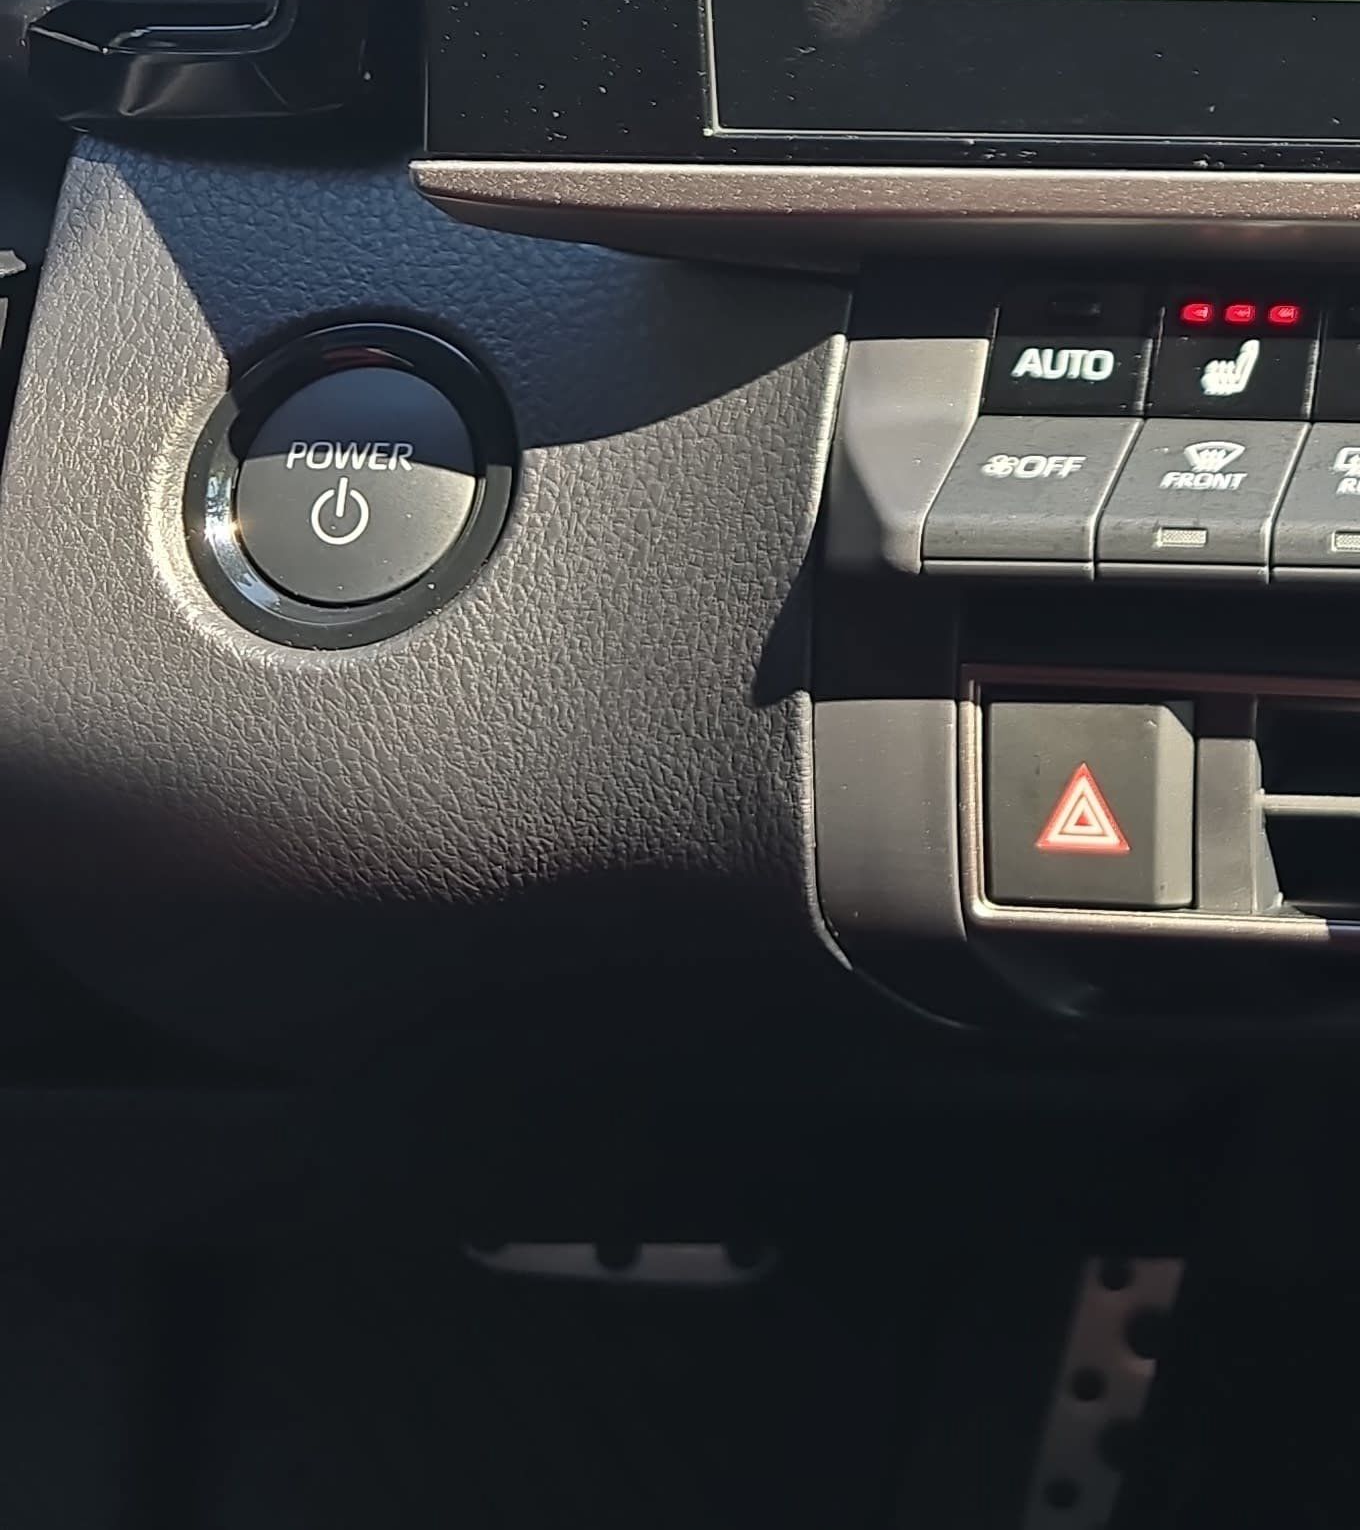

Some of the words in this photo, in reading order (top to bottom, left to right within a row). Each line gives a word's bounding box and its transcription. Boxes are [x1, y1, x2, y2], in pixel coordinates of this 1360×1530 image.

[1011, 348, 1114, 382] AUTO
[286, 441, 415, 472] POWER
[1014, 454, 1087, 479] OFF
[1159, 471, 1248, 490] FRONT
